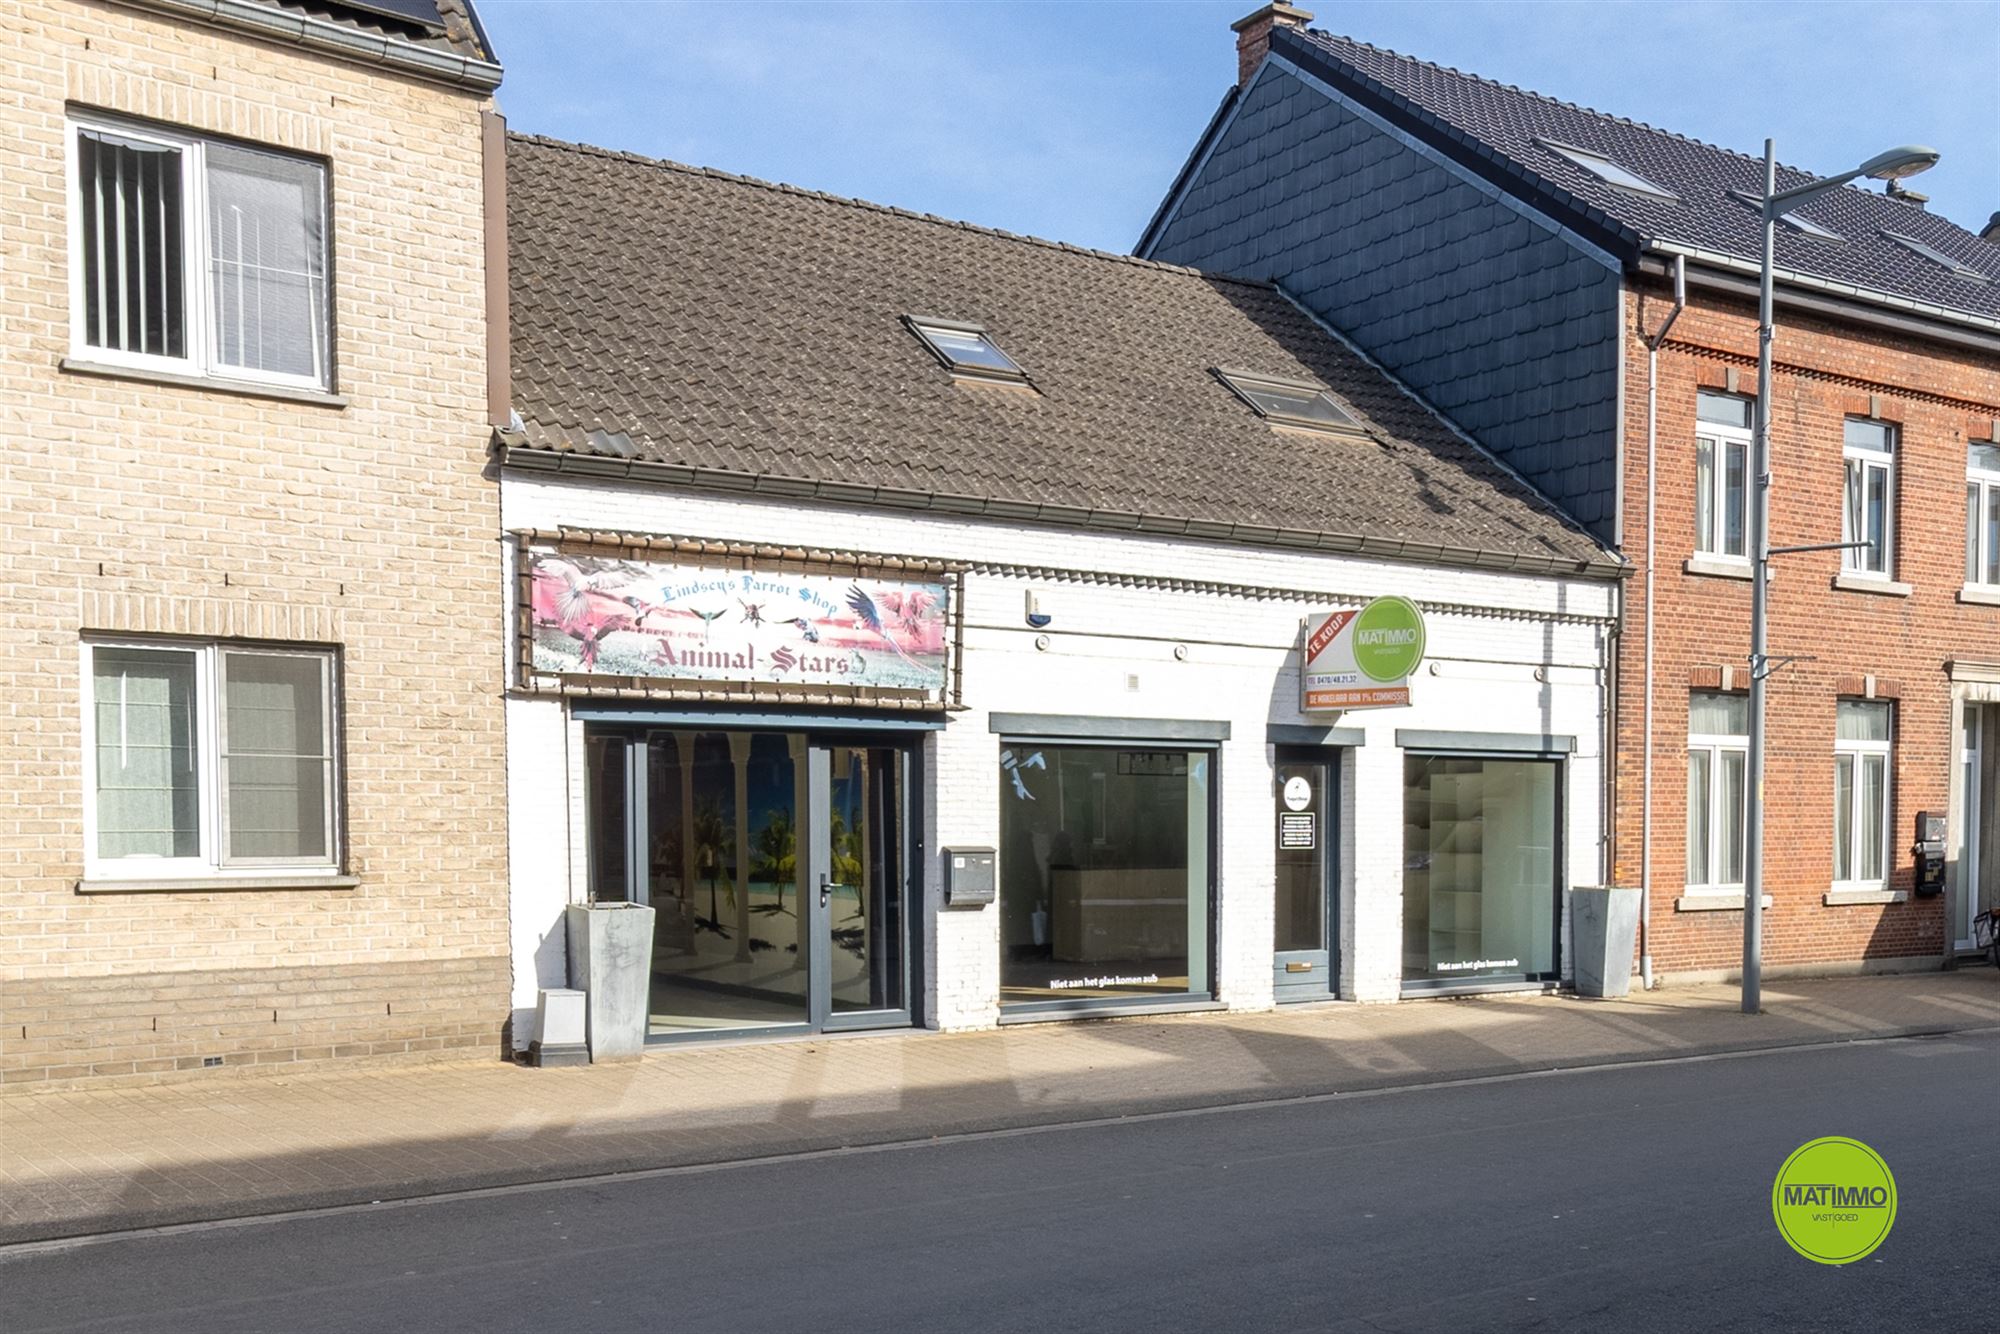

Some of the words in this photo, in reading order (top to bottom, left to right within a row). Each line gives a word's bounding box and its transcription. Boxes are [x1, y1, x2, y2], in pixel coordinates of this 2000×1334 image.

[741, 575, 790, 595] Parrot
[798, 587, 838, 618] Shop
[1309, 642, 1321, 654] TE
[1320, 614, 1345, 643] KOOP
[1358, 628, 1417, 645] MATIMMO
[1437, 962, 1451, 970] Niet
[1462, 961, 1473, 969] het
[1473, 960, 1486, 971] glas
[1486, 959, 1506, 968] komen
[1506, 958, 1519, 966] aub
[1050, 979, 1068, 989] Niet
[1068, 980, 1083, 988] aan
[1084, 977, 1098, 987] het
[1098, 976, 1115, 988] glas
[1115, 975, 1142, 985] komen
[1143, 974, 1158, 983] aub
